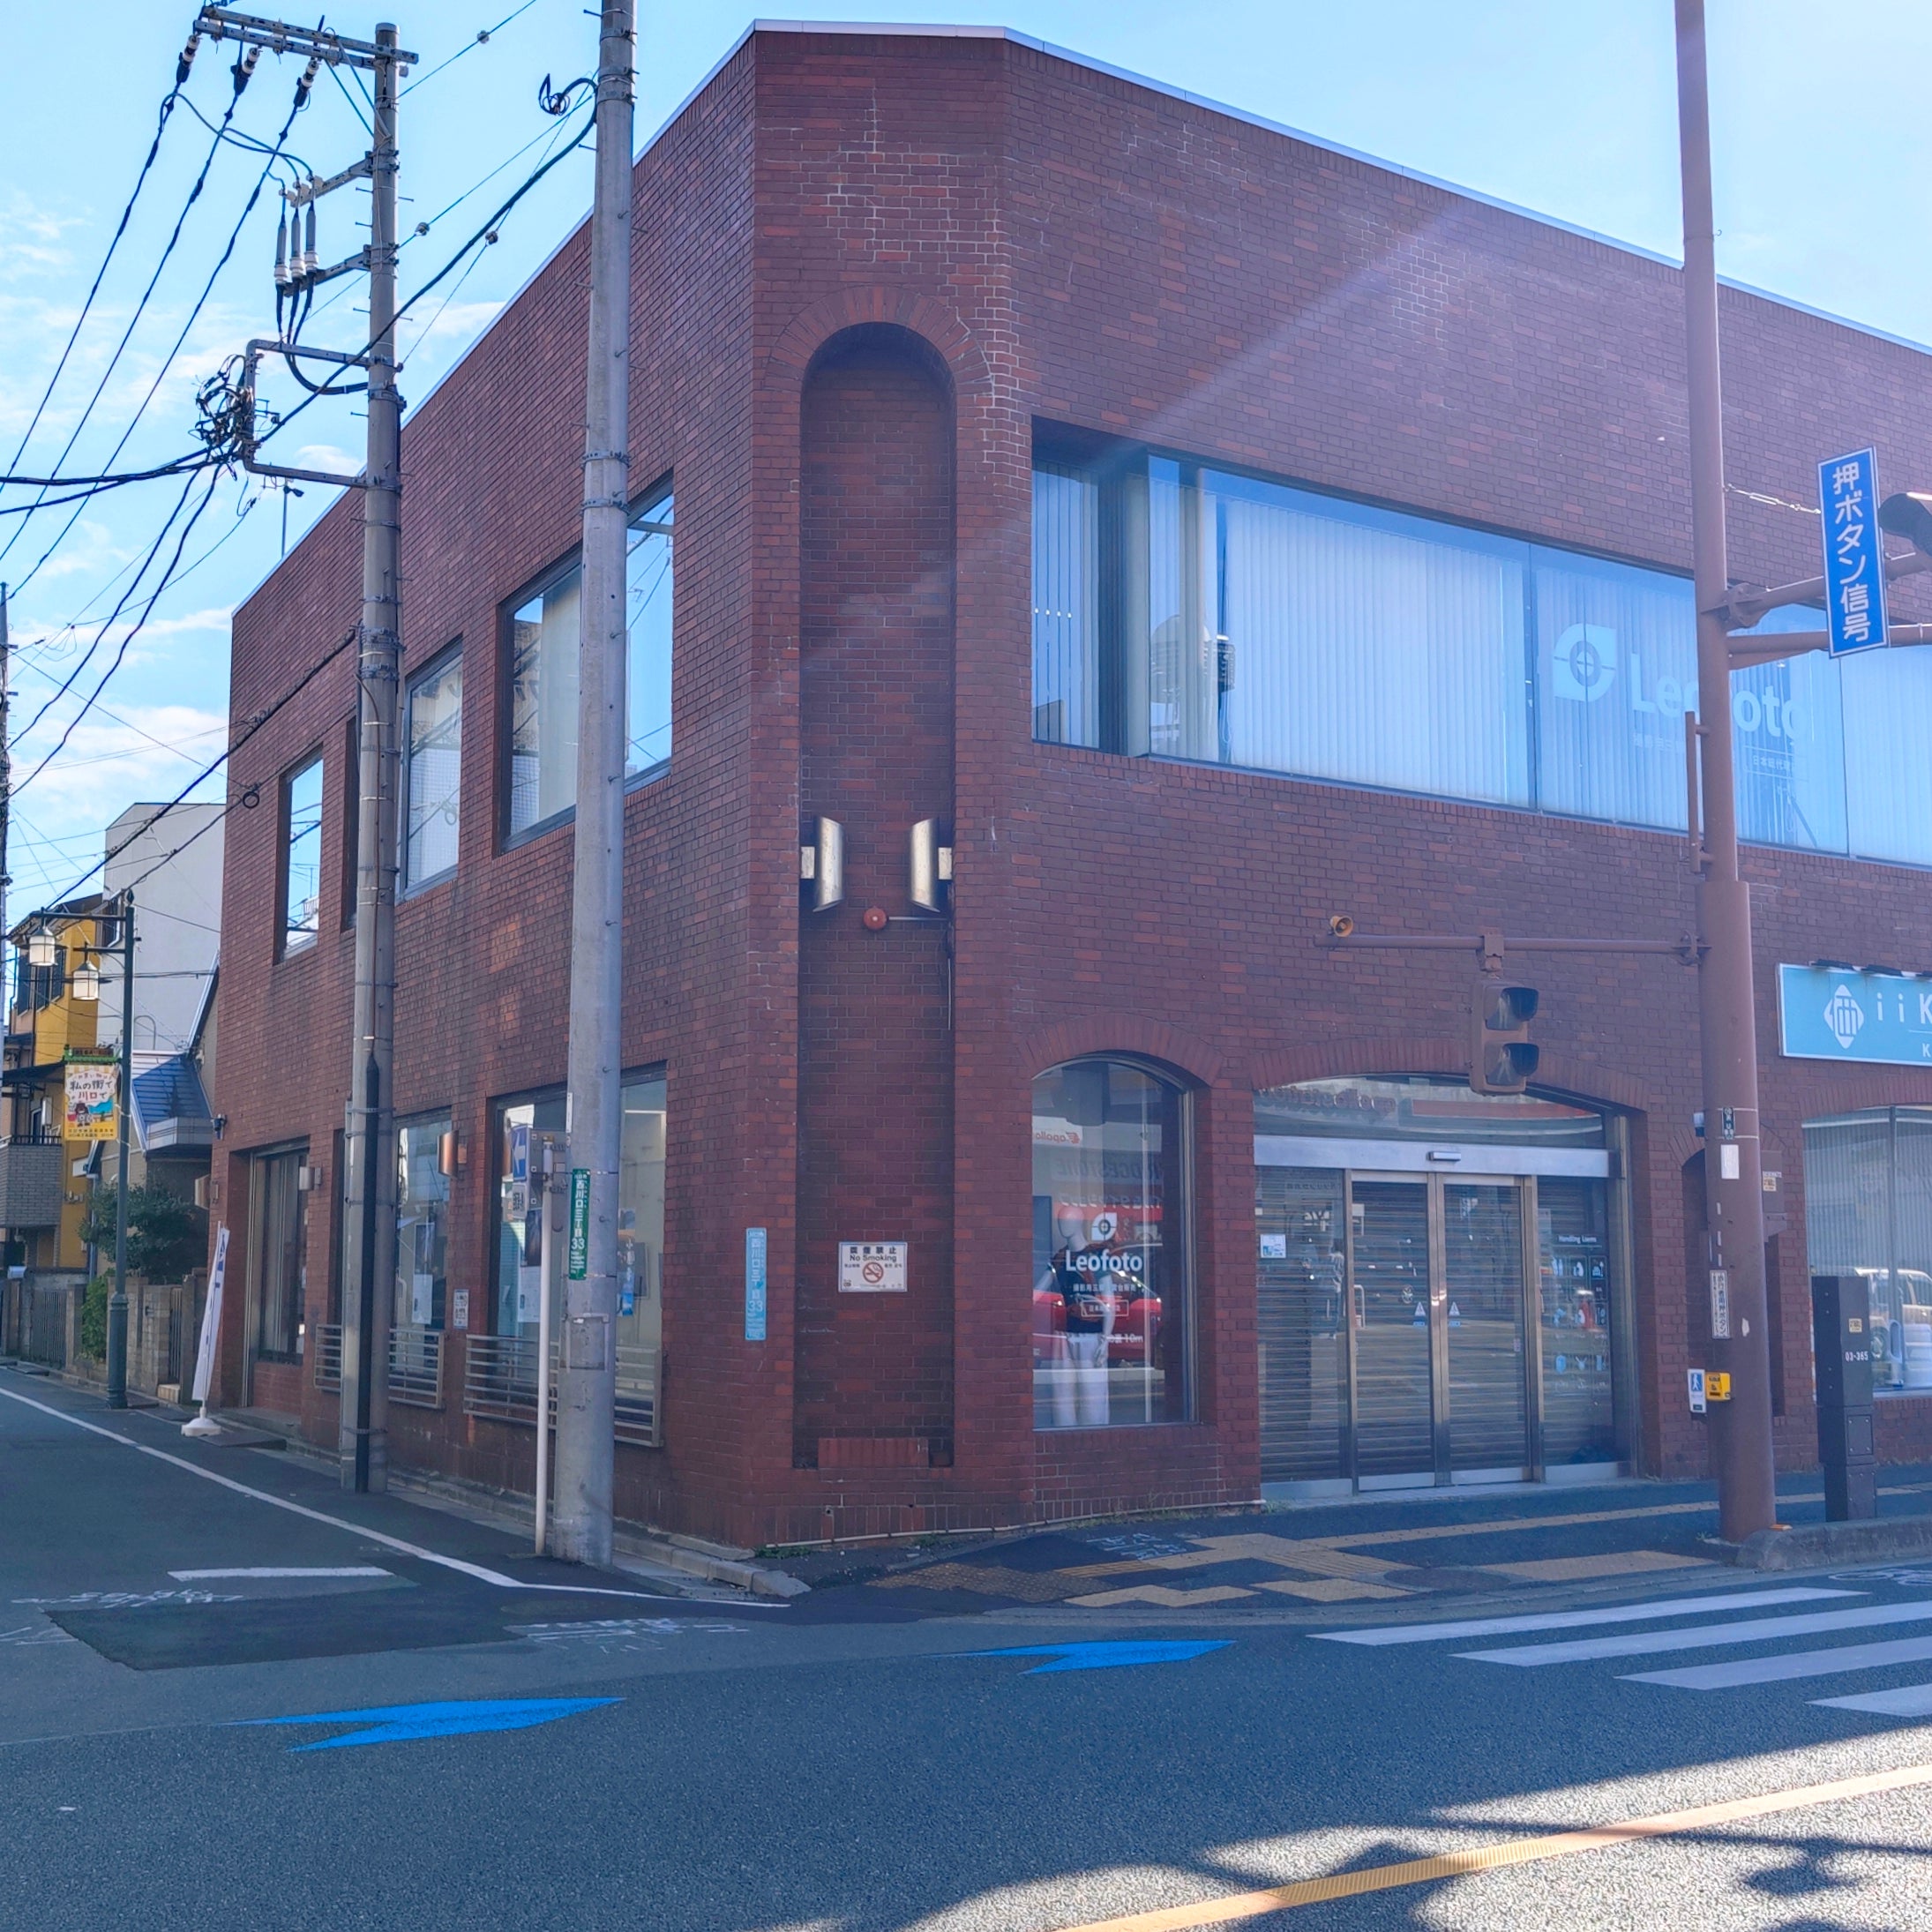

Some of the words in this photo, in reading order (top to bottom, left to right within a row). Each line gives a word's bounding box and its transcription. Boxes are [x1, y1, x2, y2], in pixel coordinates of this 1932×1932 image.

[1831, 461, 1872, 642] 押ボタン信号
[1632, 653, 1807, 739] Leoto
[571, 1238, 585, 1250] 33
[863, 1254, 897, 1262] Smoking
[1066, 1249, 1142, 1272] Leofoto
[748, 1300, 763, 1312] 33
